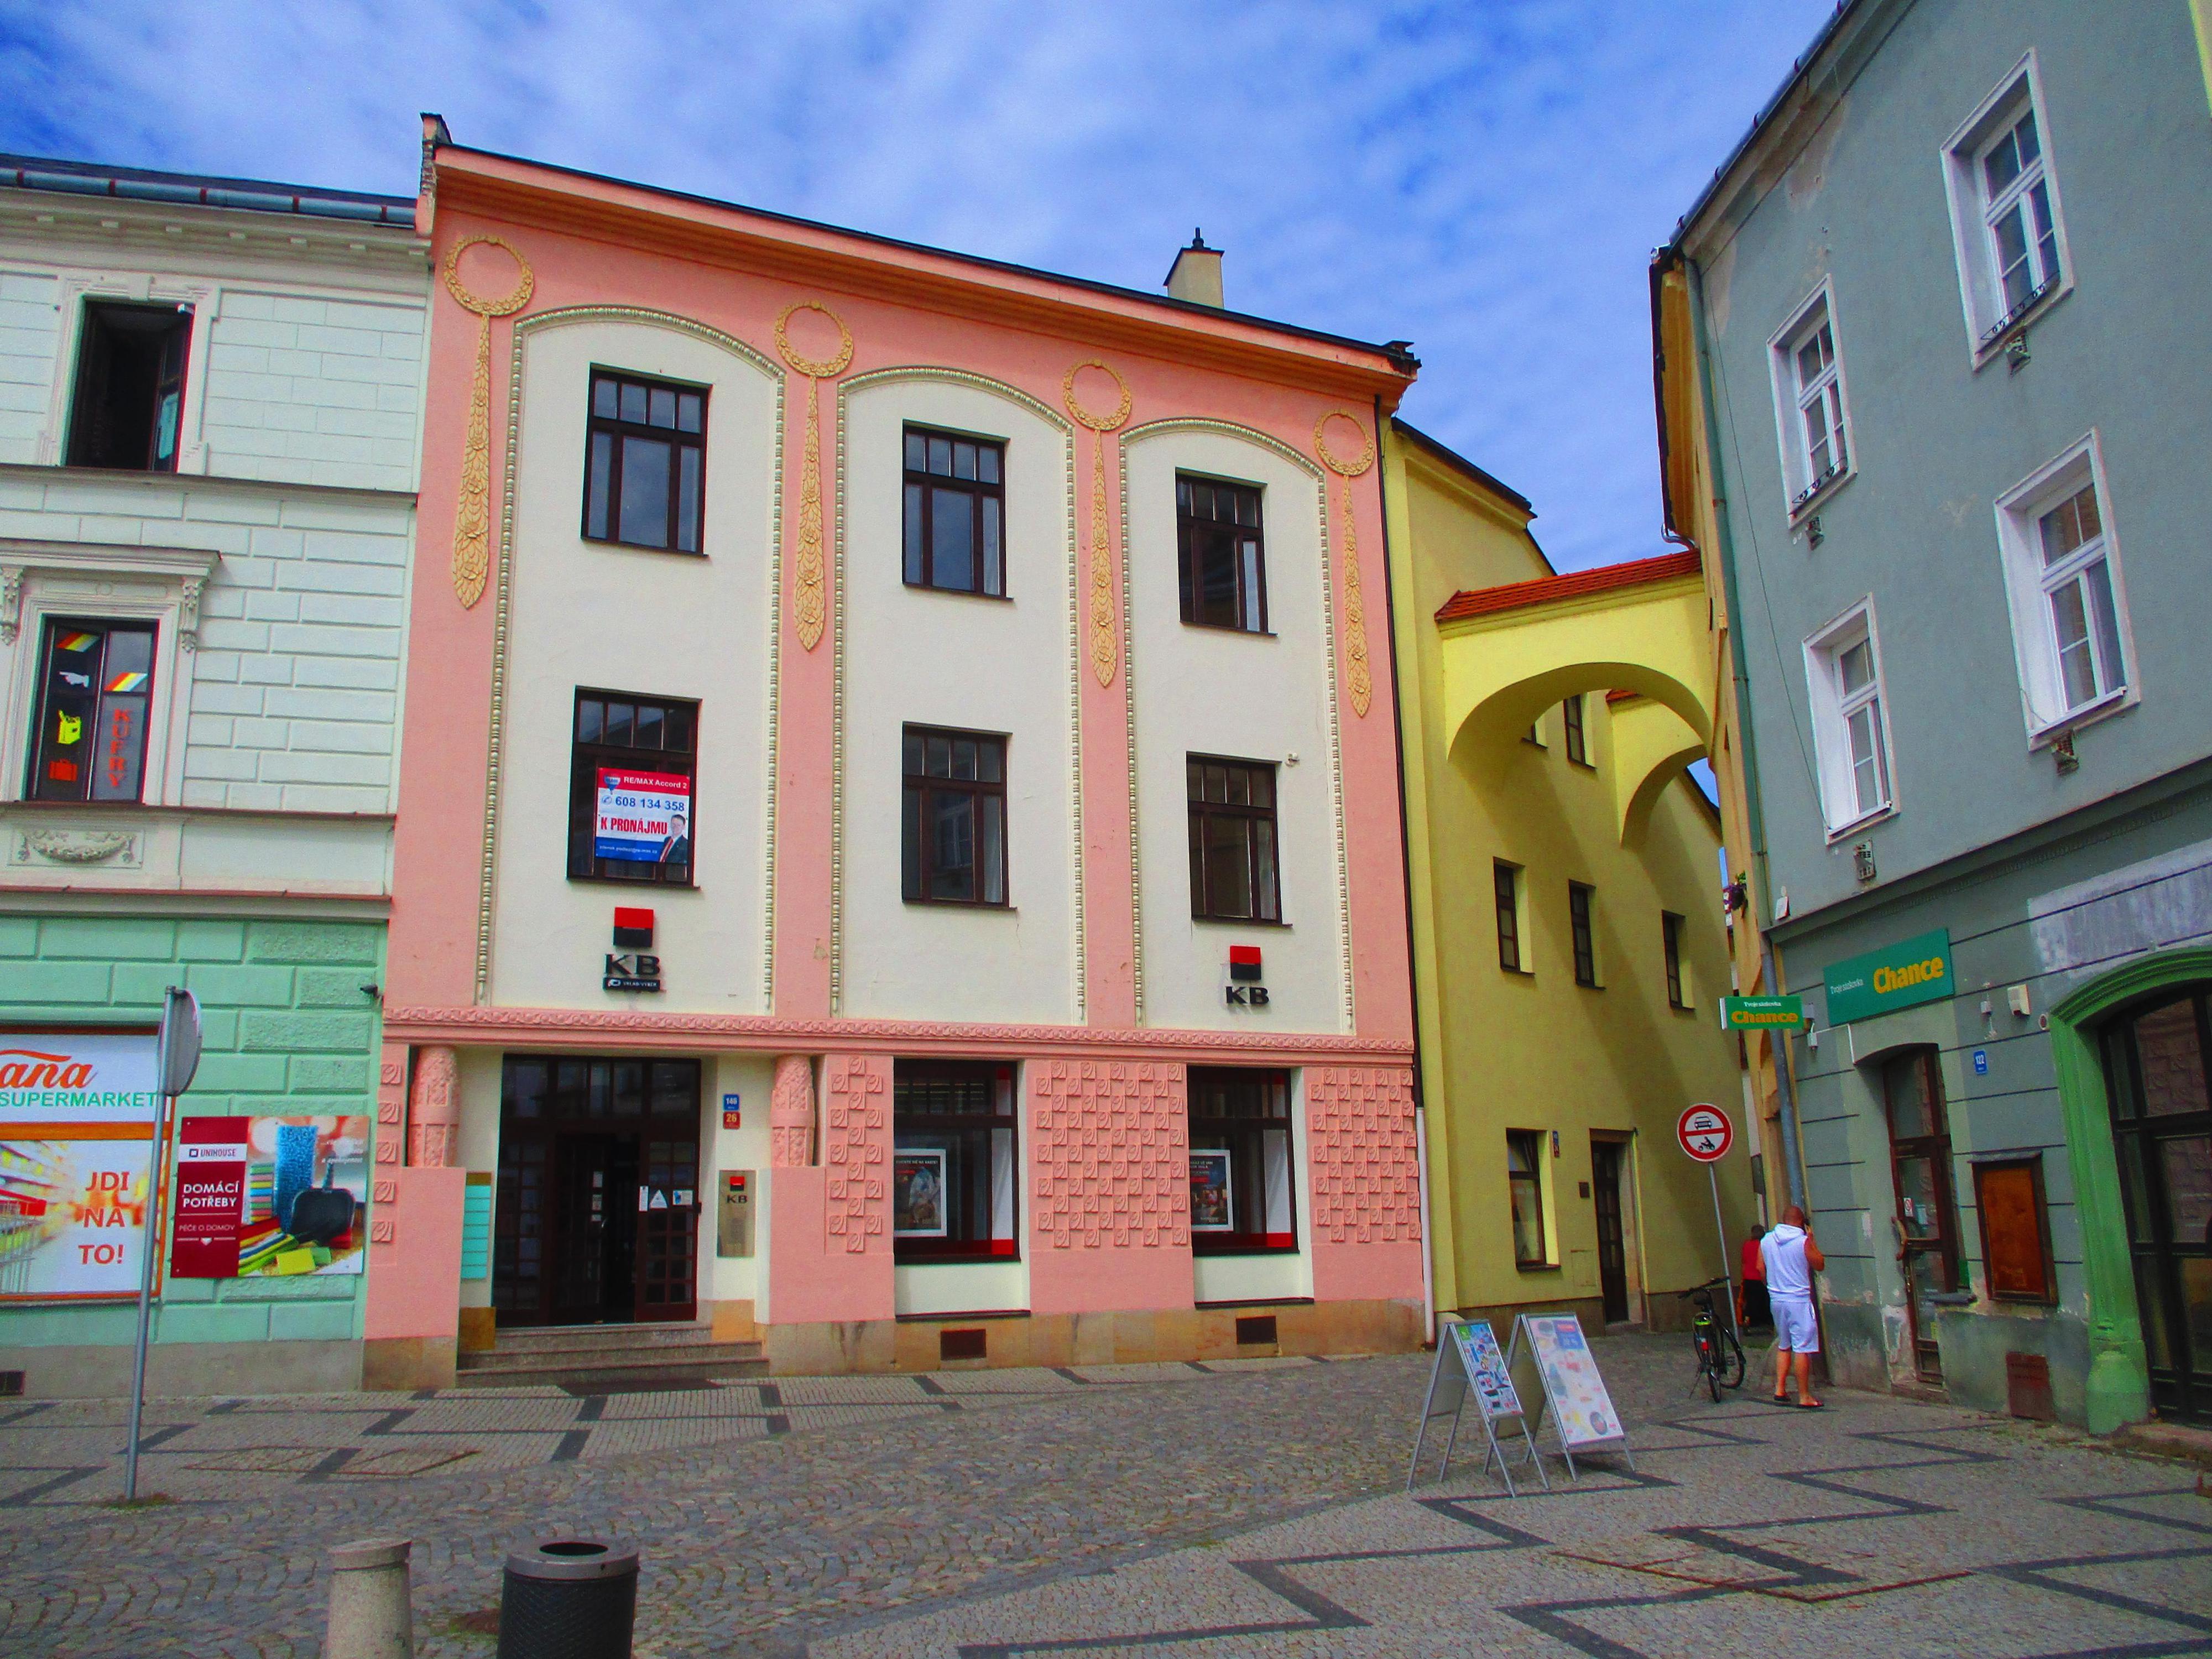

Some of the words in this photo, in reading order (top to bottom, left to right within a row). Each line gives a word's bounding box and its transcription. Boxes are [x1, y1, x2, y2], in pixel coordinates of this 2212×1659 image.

[108, 708, 131, 787] KUFRY
[623, 776, 654, 786] RE/MAX
[655, 779, 681, 789] Accord
[615, 796, 636, 807] 608
[640, 798, 661, 809] 134
[664, 800, 685, 812] 358
[601, 817, 608, 830] K
[611, 817, 668, 835] PRONÁJMU
[606, 953, 660, 975] KB
[1873, 957, 1944, 994] Chance
[1225, 986, 1270, 1004] KB
[1731, 1010, 1798, 1023] Chance
[0, 1050, 97, 1089] ana
[0, 1092, 157, 1107] SUPERMARKET
[726, 1113, 737, 1123] 26
[200, 1149, 237, 1157] UNIHOUSE
[85, 1171, 130, 1192] JDI
[183, 1180, 240, 1194] DOMÁCÍ
[182, 1194, 237, 1208] POTŘEBY
[727, 1194, 748, 1204] KB
[83, 1207, 126, 1228] NA
[78, 1244, 124, 1265] TO!
